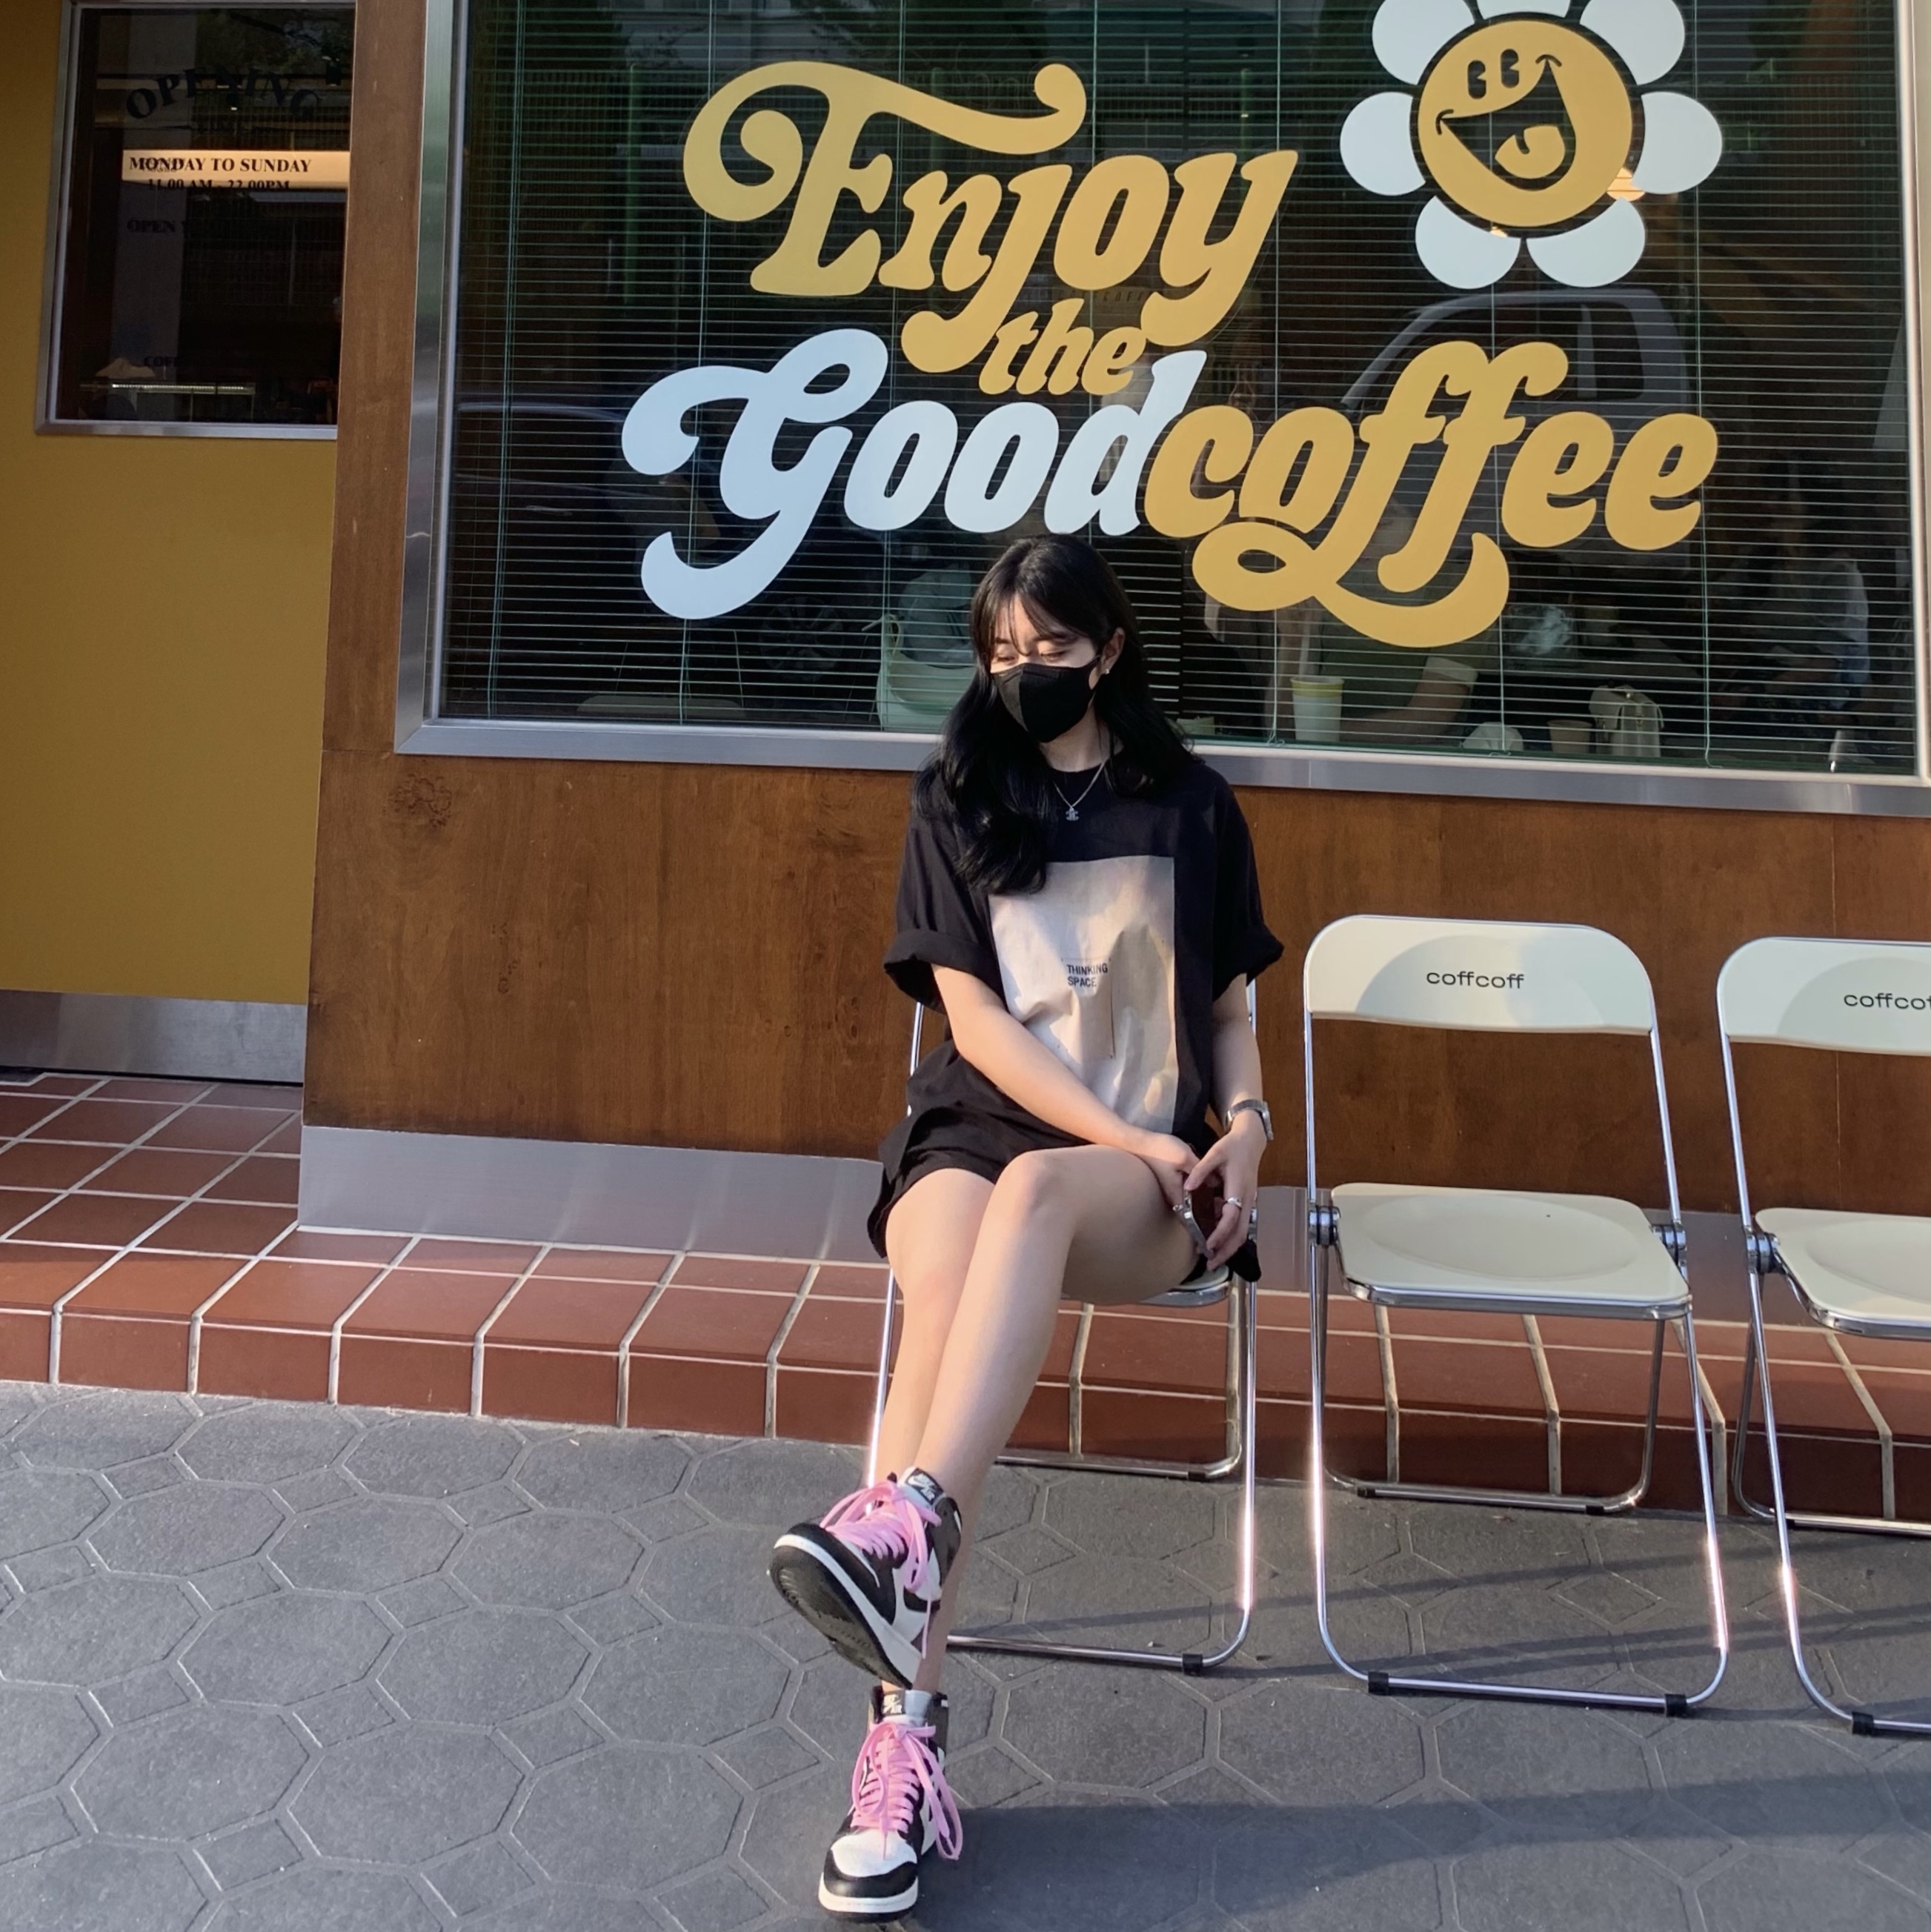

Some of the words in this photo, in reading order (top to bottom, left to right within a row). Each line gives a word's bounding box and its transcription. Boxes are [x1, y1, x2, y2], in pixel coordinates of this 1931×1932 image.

[130, 156, 206, 171] MONDAY
[210, 157, 235, 171] TO
[239, 158, 311, 173] SUNDAY
[683, 61, 1299, 373] Enjoy
[979, 298, 1147, 395] the
[1066, 963, 1109, 975] THINKING
[1067, 976, 1097, 988] SPACE
[1426, 971, 1524, 989] coffcoff
